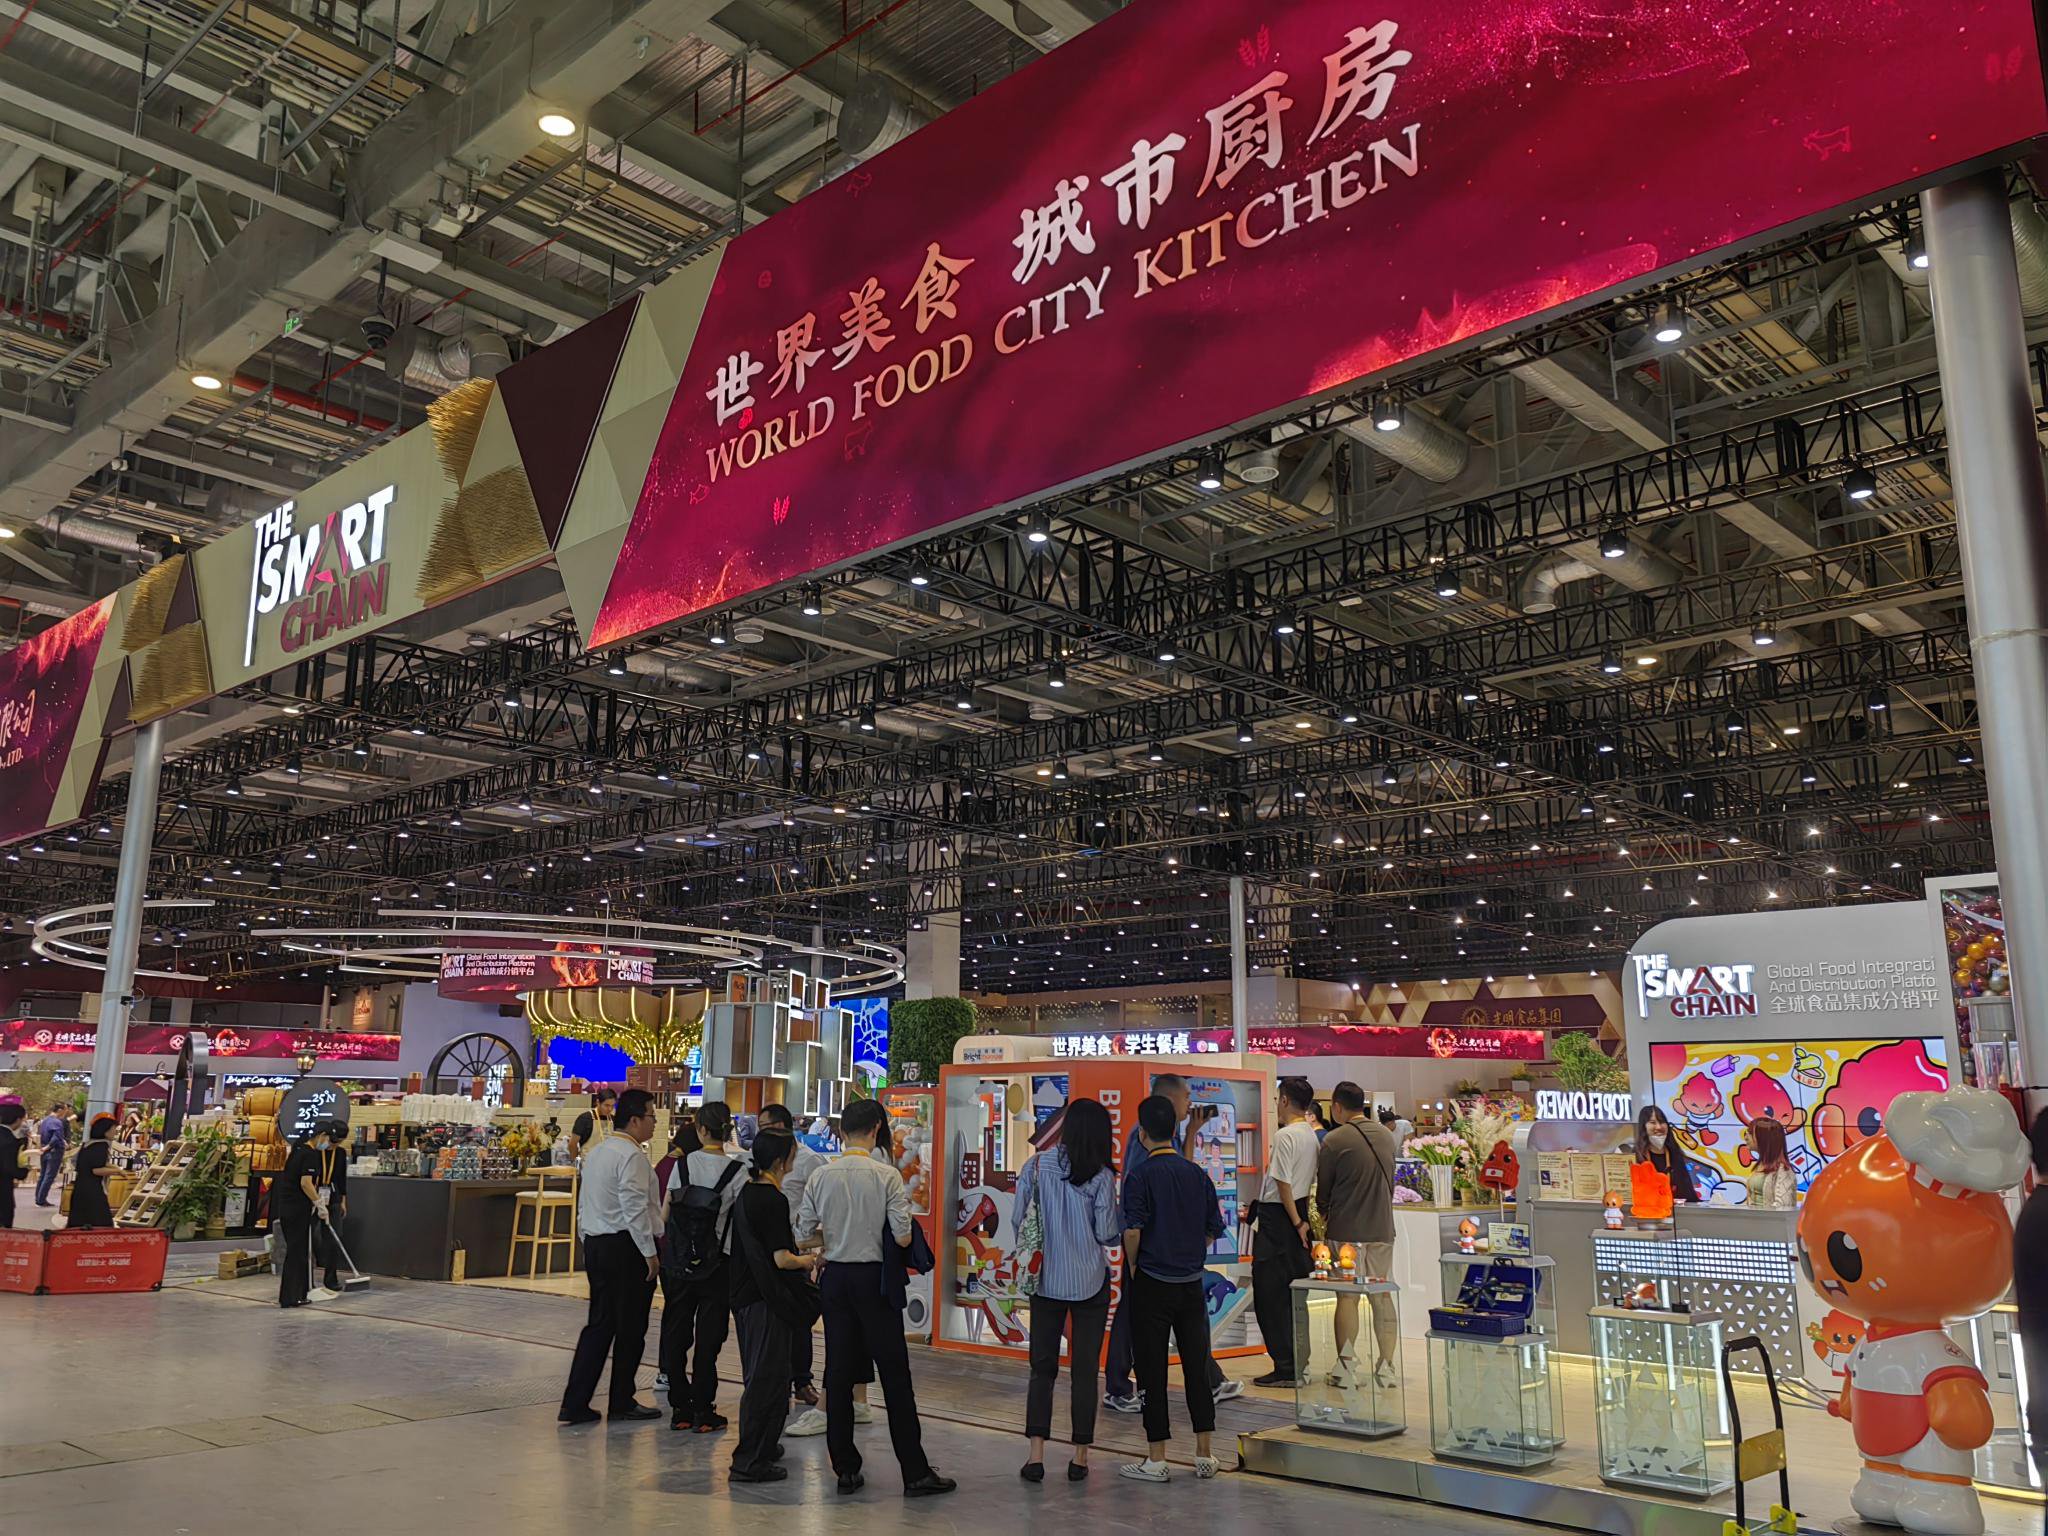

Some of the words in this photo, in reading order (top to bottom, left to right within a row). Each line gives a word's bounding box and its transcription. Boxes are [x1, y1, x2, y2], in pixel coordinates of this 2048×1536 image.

[705, 242, 975, 427] 世界美食
[1011, 19, 1413, 285] 城市厨房
[706, 396, 835, 483] WORLD
[852, 333, 974, 423] FOOD
[993, 265, 1112, 355] CITY
[1132, 122, 1422, 299] KITCHEN
[257, 484, 396, 613] SMART
[280, 562, 391, 653] CHAIN
[1644, 964, 1754, 998] SMART
[1767, 963, 1814, 979] Global
[1818, 961, 1857, 976] Food
[1862, 956, 1936, 976] Integrati
[1769, 980, 1797, 993] And
[1800, 976, 1886, 993] Distribution
[1891, 974, 1936, 989] Platfo
[1670, 994, 1758, 1019] CHAIN
[1770, 989, 1940, 1014] 全球食品集成分销平
[1053, 1035, 1113, 1057] 世界美食
[1125, 1031, 1189, 1055] 学生餐桌
